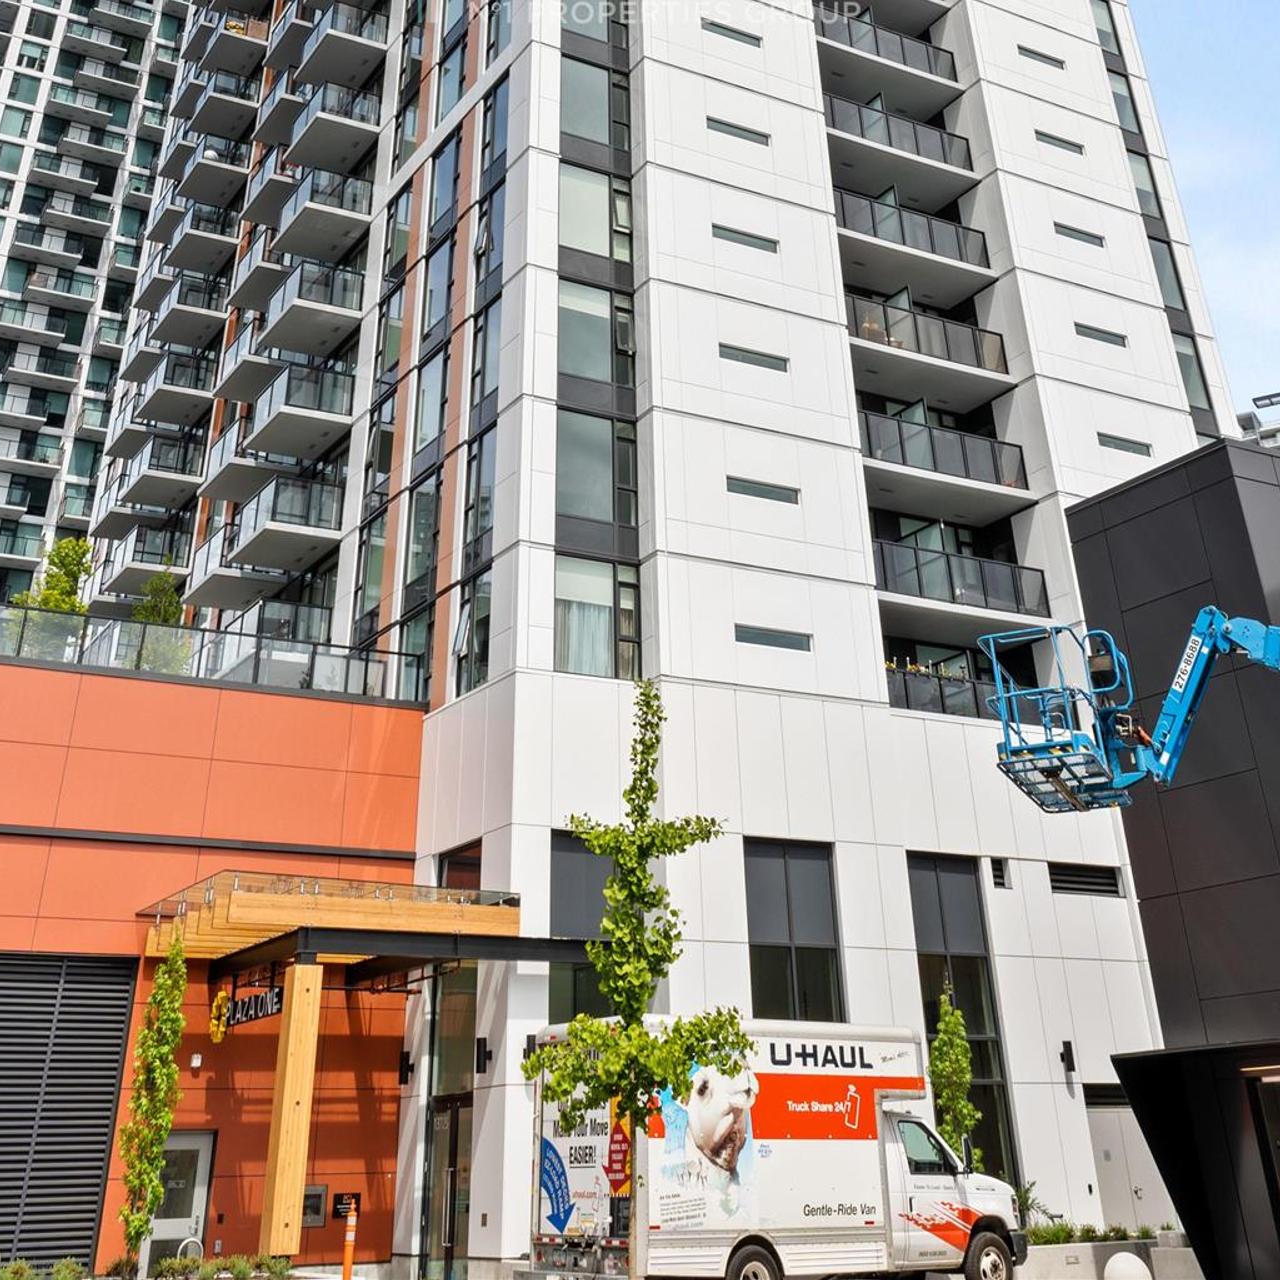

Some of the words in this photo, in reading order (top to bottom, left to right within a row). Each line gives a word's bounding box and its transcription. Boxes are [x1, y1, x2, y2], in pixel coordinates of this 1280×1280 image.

[225, 995, 256, 1025] PLAZA
[257, 987, 281, 1018] ONE
[769, 1042, 874, 1070] U-HAUL
[787, 1101, 810, 1112] Truck
[811, 1101, 834, 1112] Share
[834, 1101, 852, 1114] 24/7
[589, 1118, 609, 1137] Move
[569, 1145, 597, 1165] EASIER!
[803, 1203, 858, 1217] Gentle-Ride
[860, 1202, 877, 1215] Van
